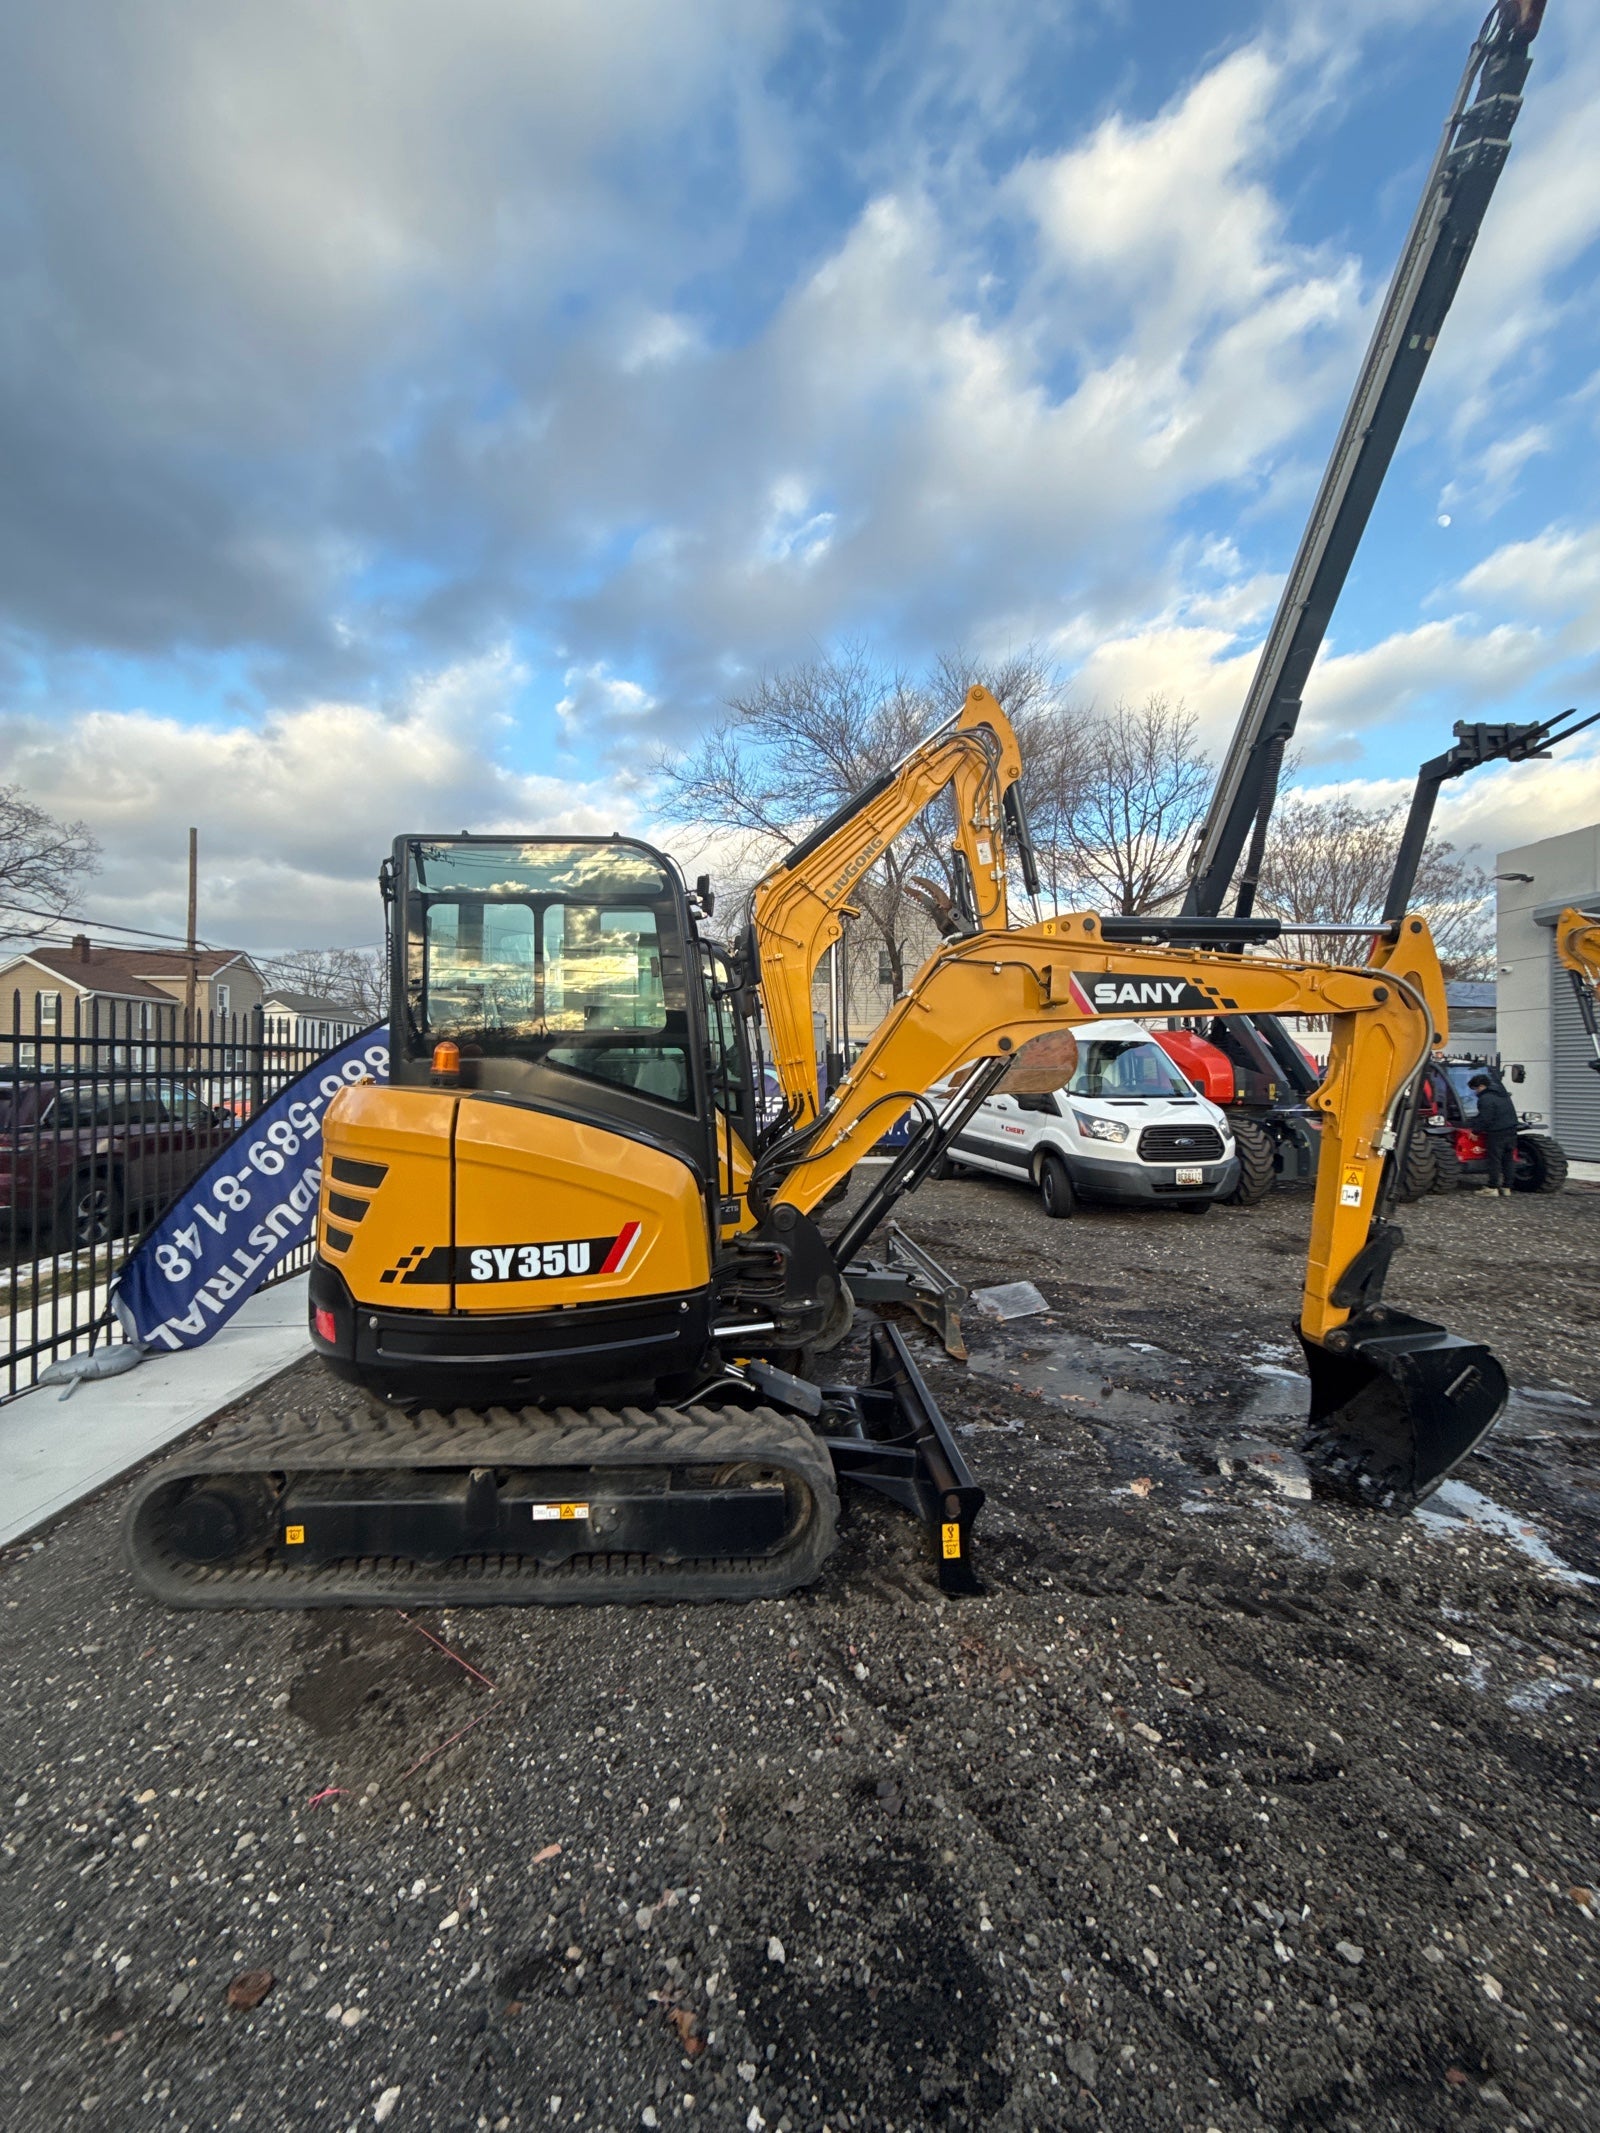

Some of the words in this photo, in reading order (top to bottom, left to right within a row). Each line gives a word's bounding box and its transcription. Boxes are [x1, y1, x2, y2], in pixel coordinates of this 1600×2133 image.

[1094, 982, 1187, 1004] SANY
[143, 1156, 323, 1350] NDUSTRIAL
[470, 1242, 590, 1281] SY35U
